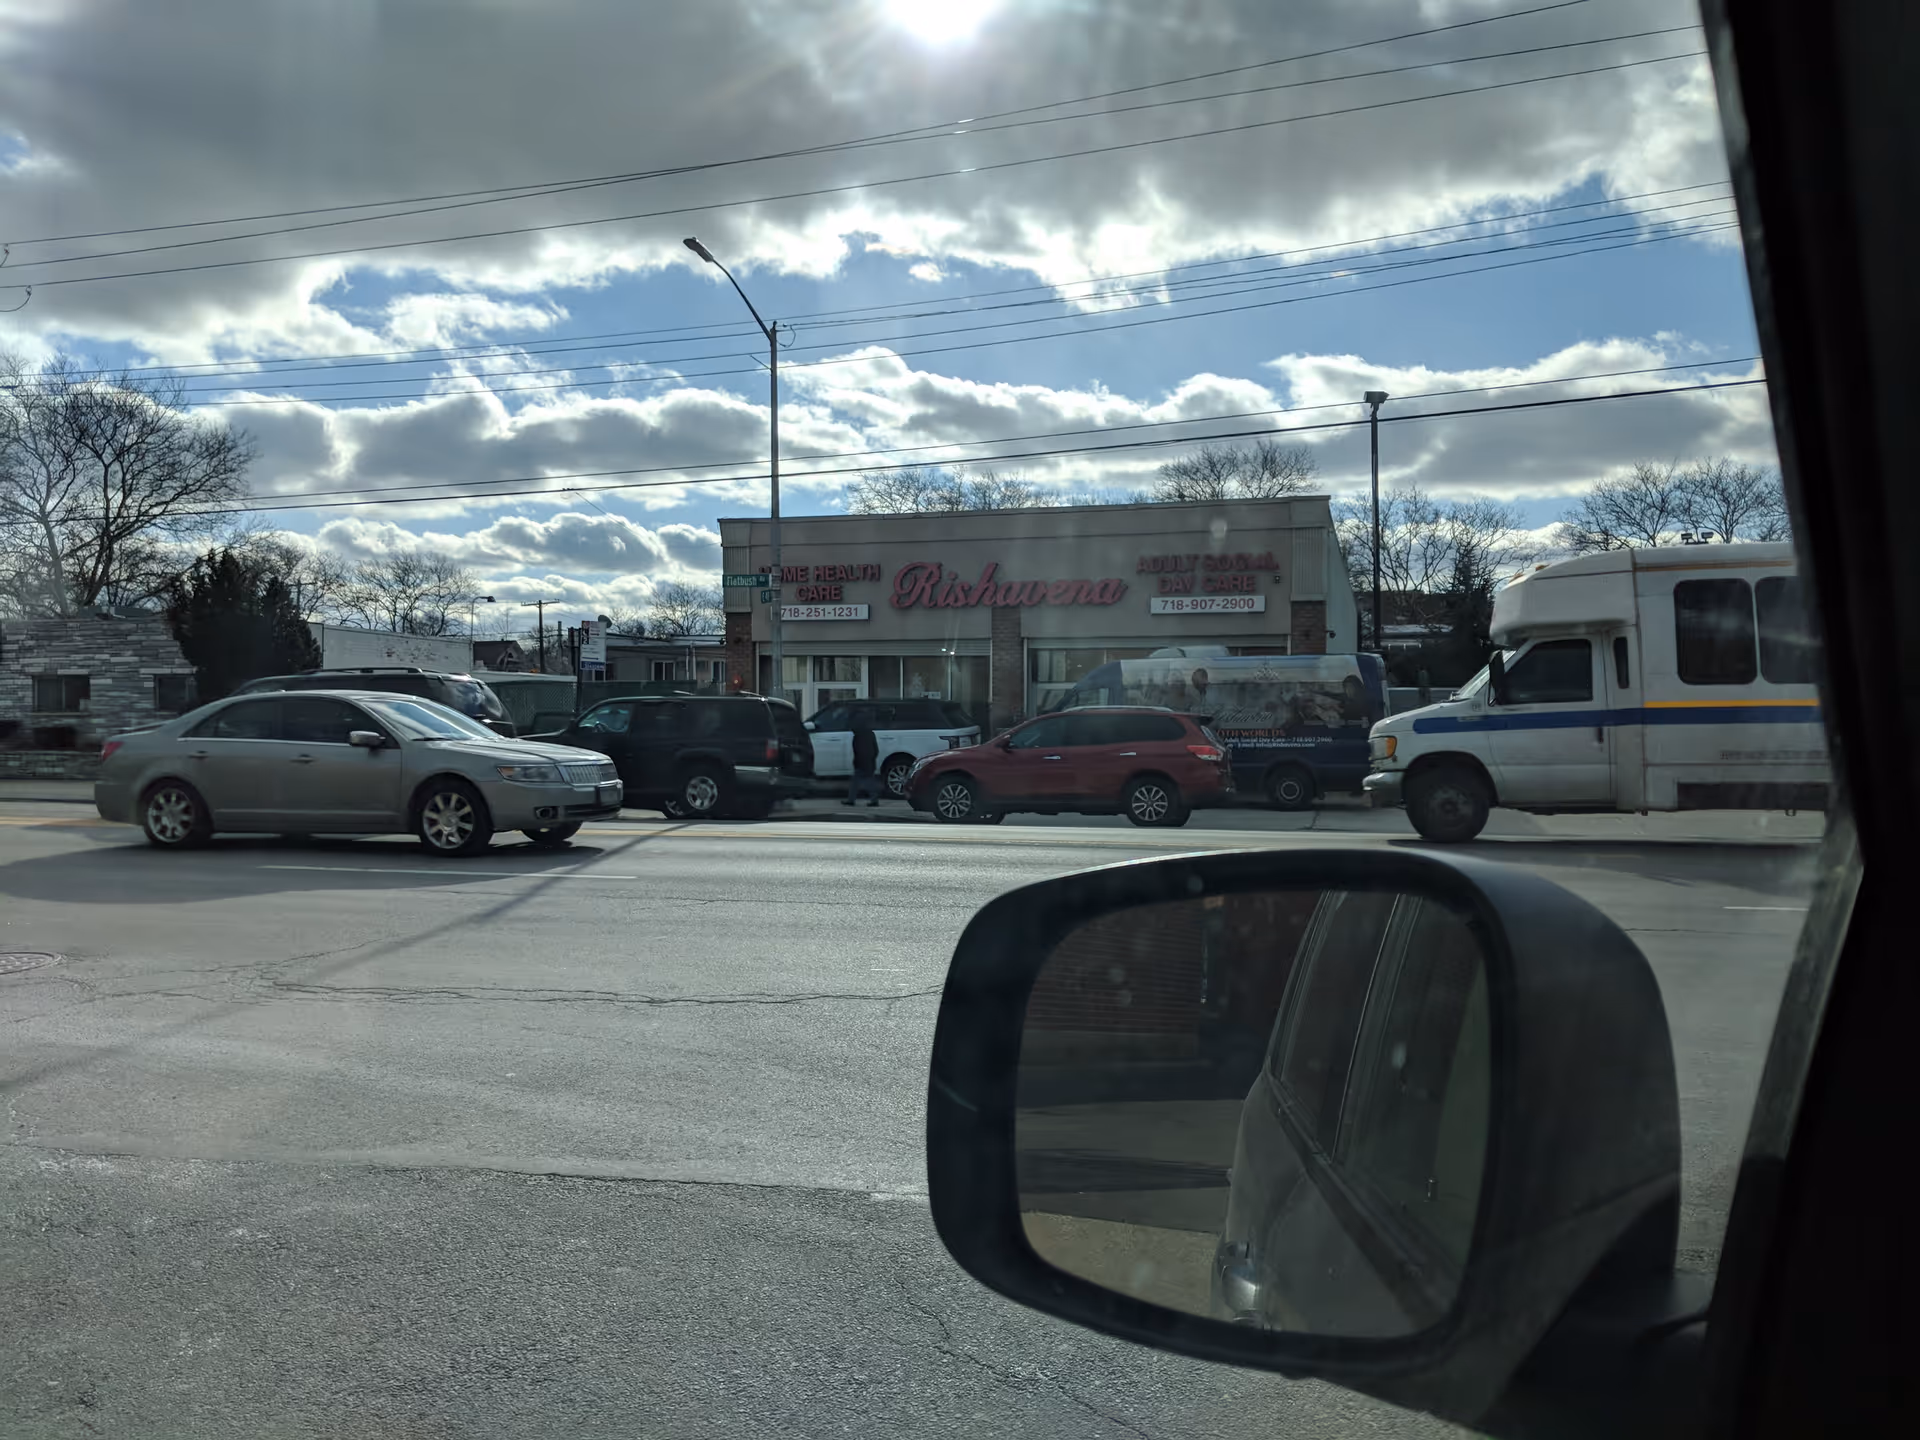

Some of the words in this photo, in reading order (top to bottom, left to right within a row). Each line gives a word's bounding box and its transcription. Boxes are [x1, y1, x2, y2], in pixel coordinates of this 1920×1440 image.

[1136, 555, 1200, 573] ADULT
[727, 576, 757, 586] Flatbush
[813, 564, 881, 582] HEALTH
[889, 562, 1128, 609] Rishavena
[1158, 575, 1193, 593] DAY
[1202, 575, 1256, 593] CARE
[796, 585, 842, 602] CARE
[781, 607, 858, 618] 718-251-1231
[1161, 598, 1255, 610] 718-907-2900
